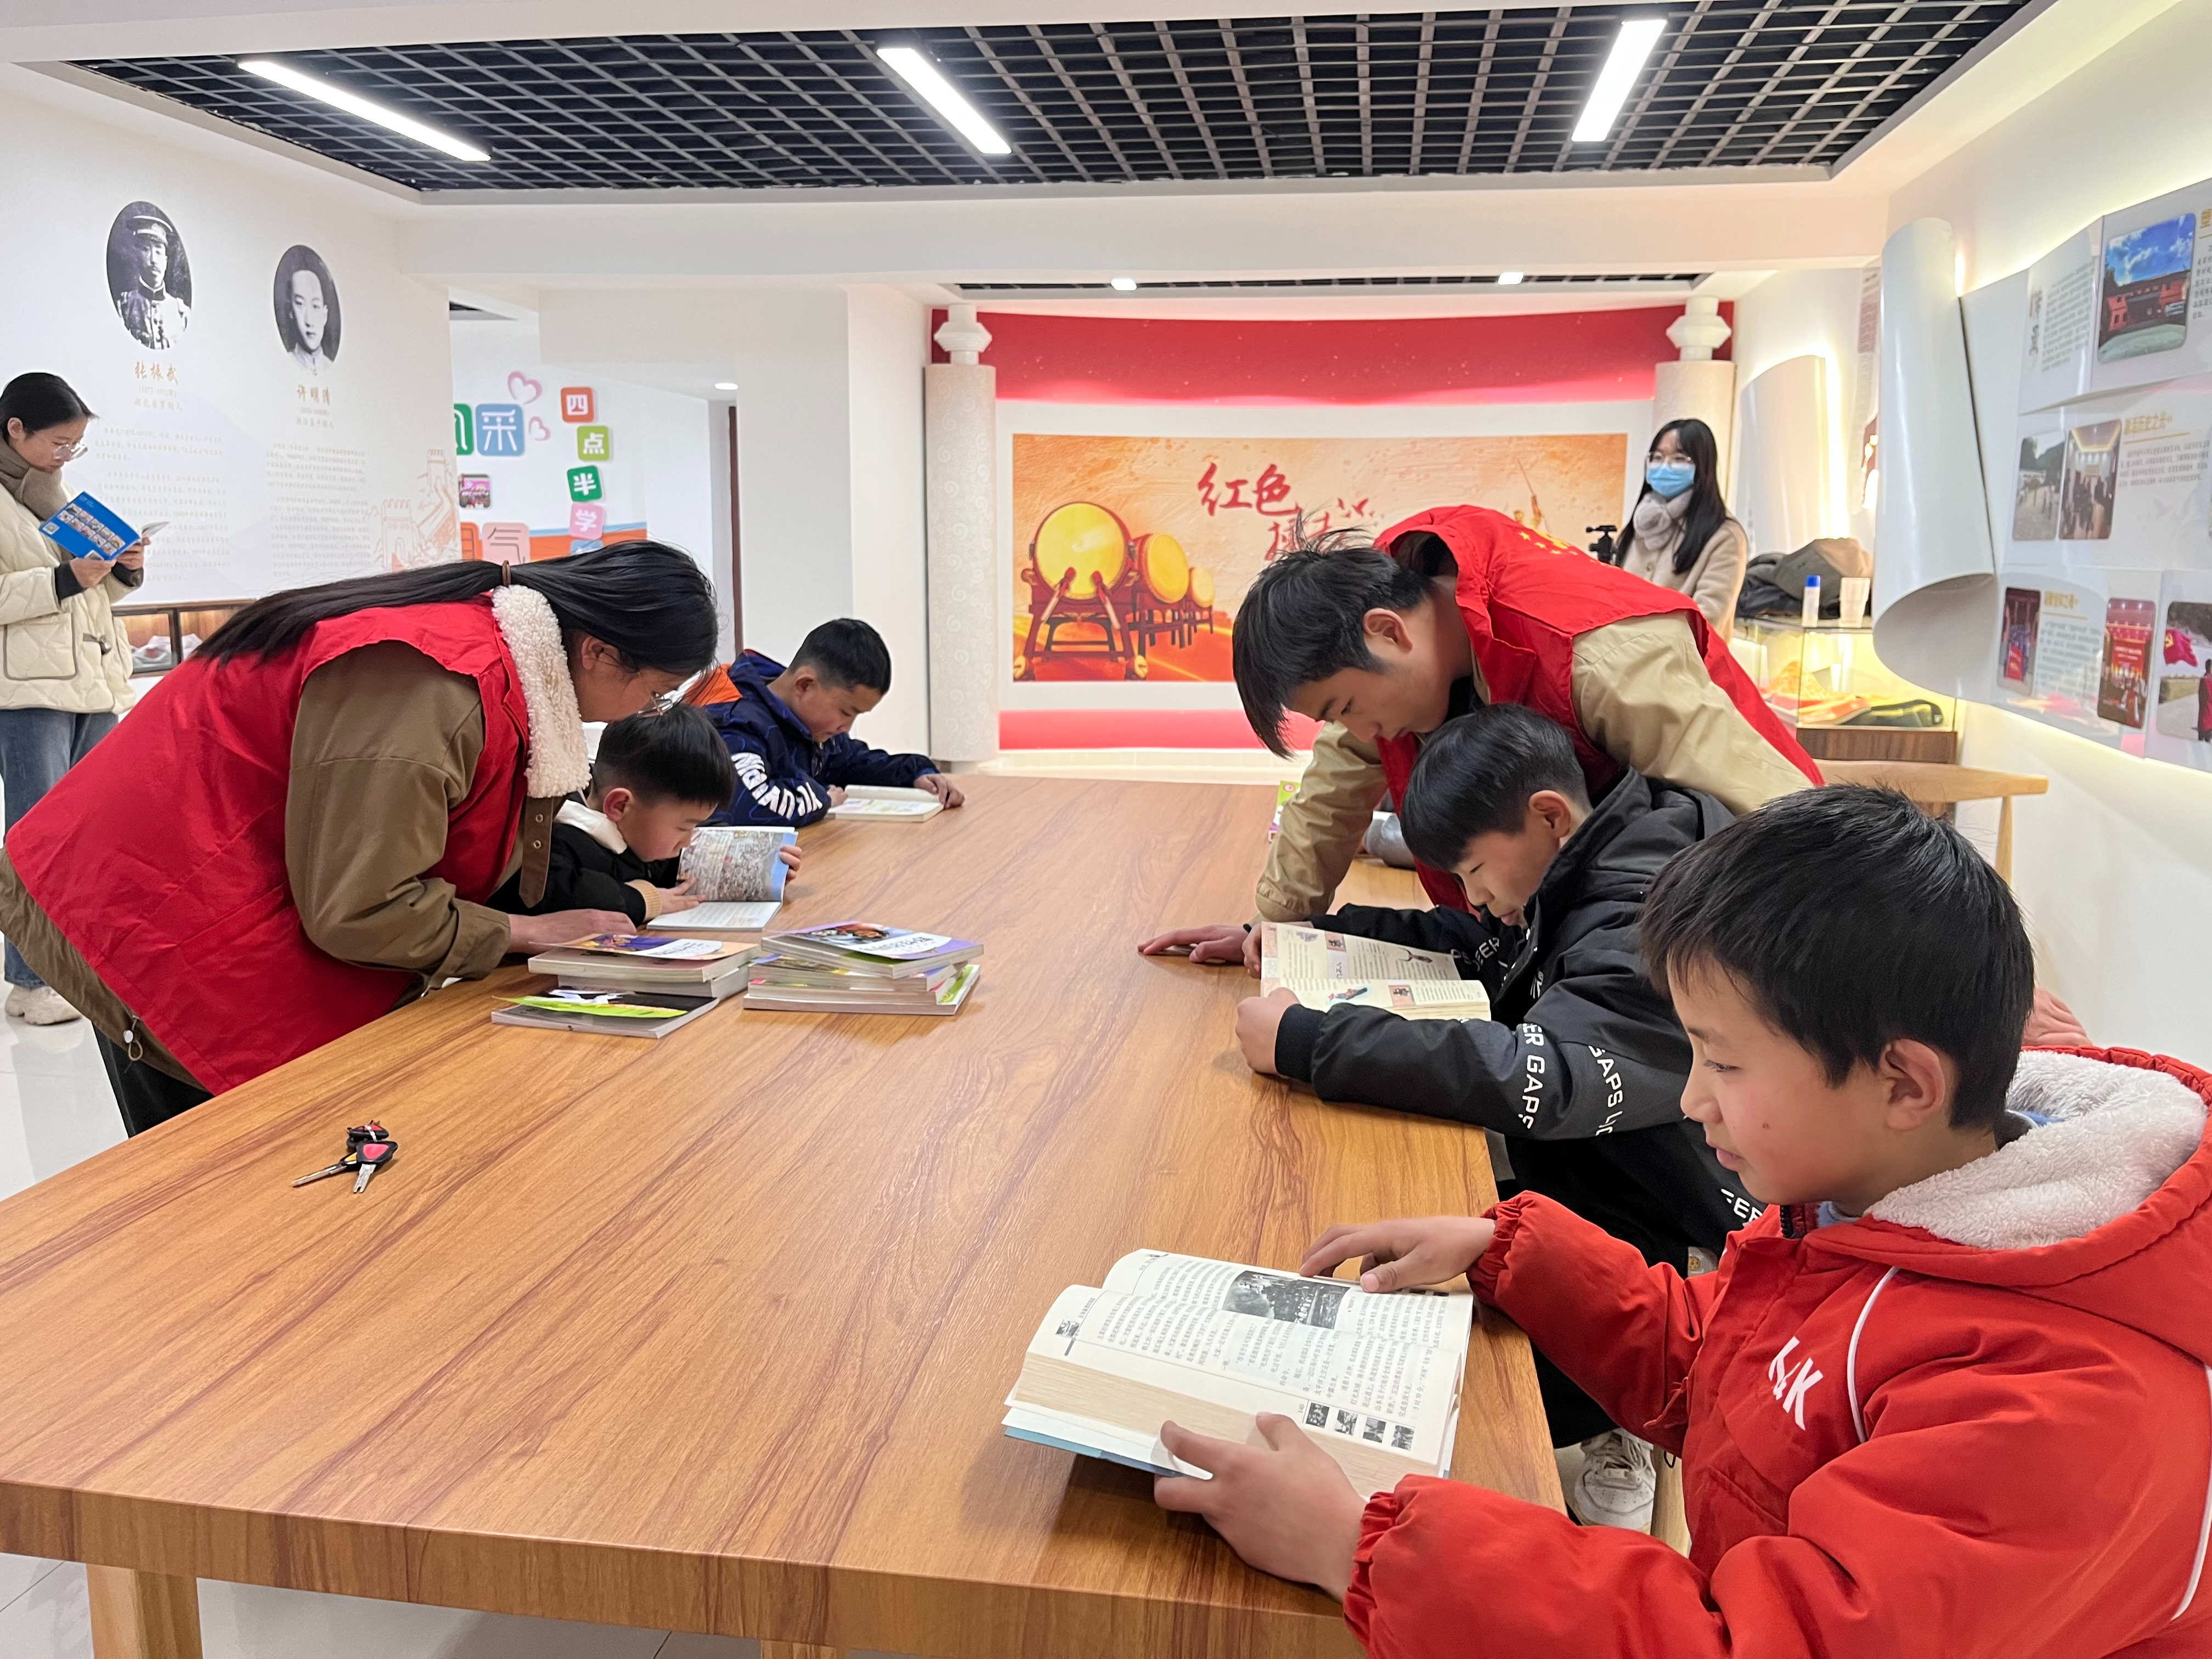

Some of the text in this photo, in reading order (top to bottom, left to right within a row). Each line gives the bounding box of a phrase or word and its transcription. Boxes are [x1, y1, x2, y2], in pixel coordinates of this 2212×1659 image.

[567, 394, 604, 554] 四点半学
[1198, 462, 1302, 516] 红色
